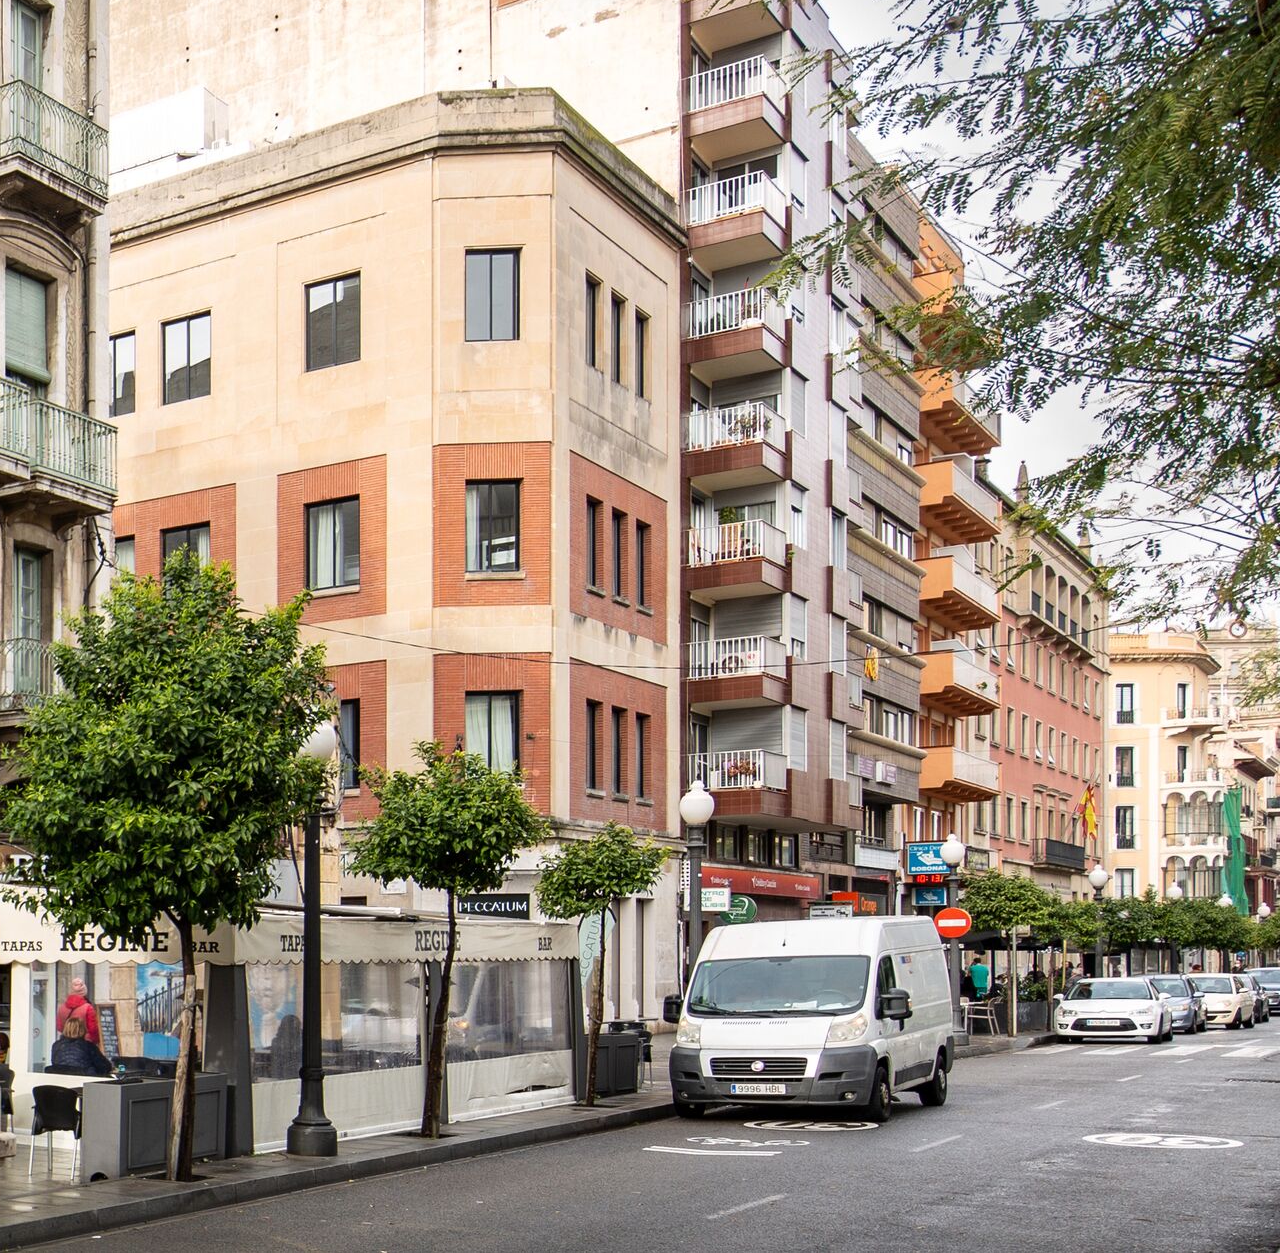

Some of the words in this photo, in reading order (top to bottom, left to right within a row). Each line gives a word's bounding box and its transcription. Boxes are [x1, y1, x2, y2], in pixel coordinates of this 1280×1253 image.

[458, 901, 528, 913] PECCATUM
[1, 941, 43, 952] TAPAS
[60, 932, 169, 952] REGINE
[538, 937, 552, 951] BAR
[737, 1085, 761, 1093] 9996
[765, 1085, 783, 1093] HBL
